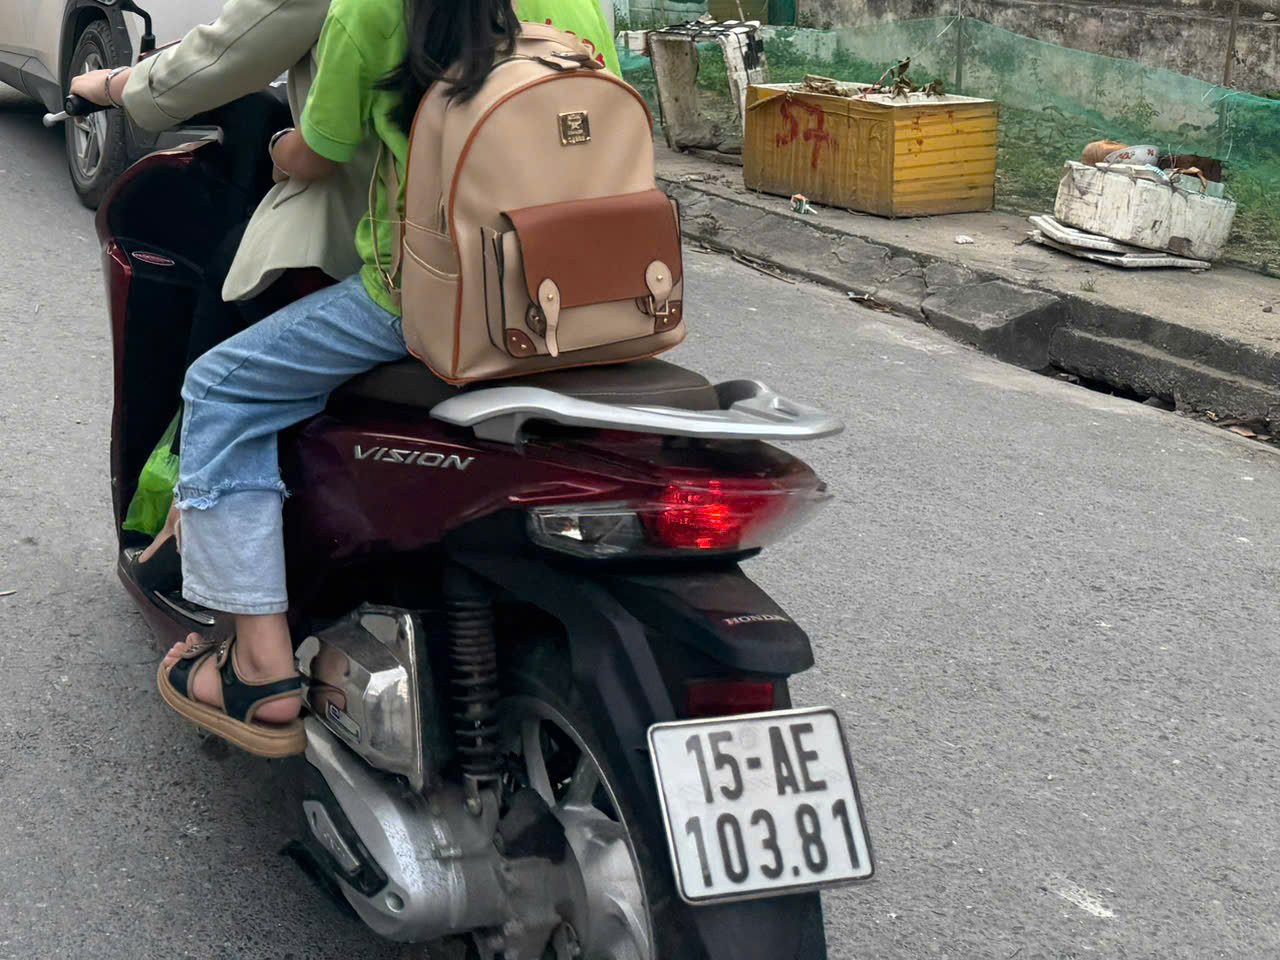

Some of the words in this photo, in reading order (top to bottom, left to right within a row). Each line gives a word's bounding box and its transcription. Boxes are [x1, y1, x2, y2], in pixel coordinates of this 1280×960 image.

[354, 444, 476, 471] VISION
[723, 614, 791, 625] HONDA
[685, 722, 828, 804] 15-AE
[685, 798, 861, 888] 103.81
